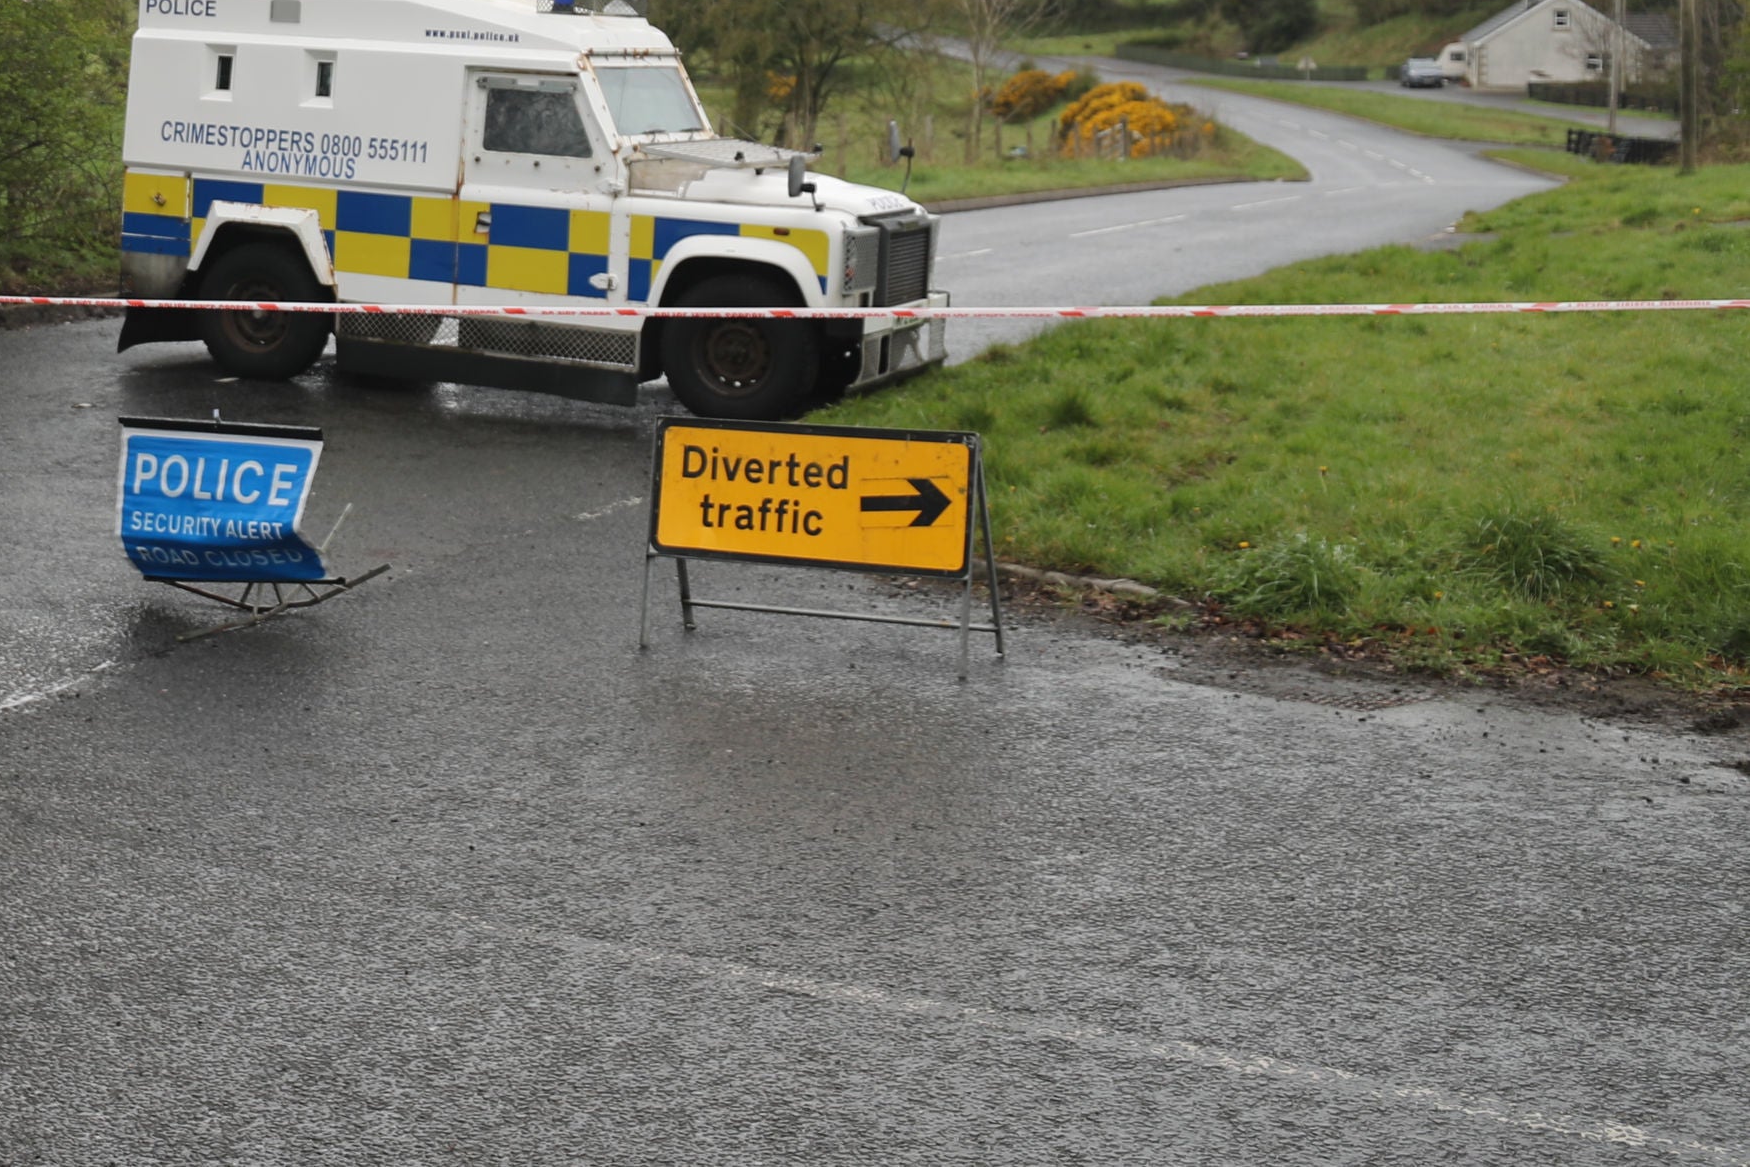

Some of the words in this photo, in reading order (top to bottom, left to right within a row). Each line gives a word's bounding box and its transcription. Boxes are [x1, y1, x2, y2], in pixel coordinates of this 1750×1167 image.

[161, 120, 315, 154] CRIMESTOPPERS
[321, 133, 363, 158] 0800
[368, 137, 428, 163] 555111
[241, 149, 356, 180] ANONYMOUS
[132, 452, 298, 507] POLICE
[681, 444, 850, 490] Diverted
[131, 510, 222, 538] SECURITY
[225, 518, 284, 541] ALERT
[700, 494, 824, 536] traffic
[136, 545, 200, 566] ROAD
[204, 546, 304, 567] CLOSED
